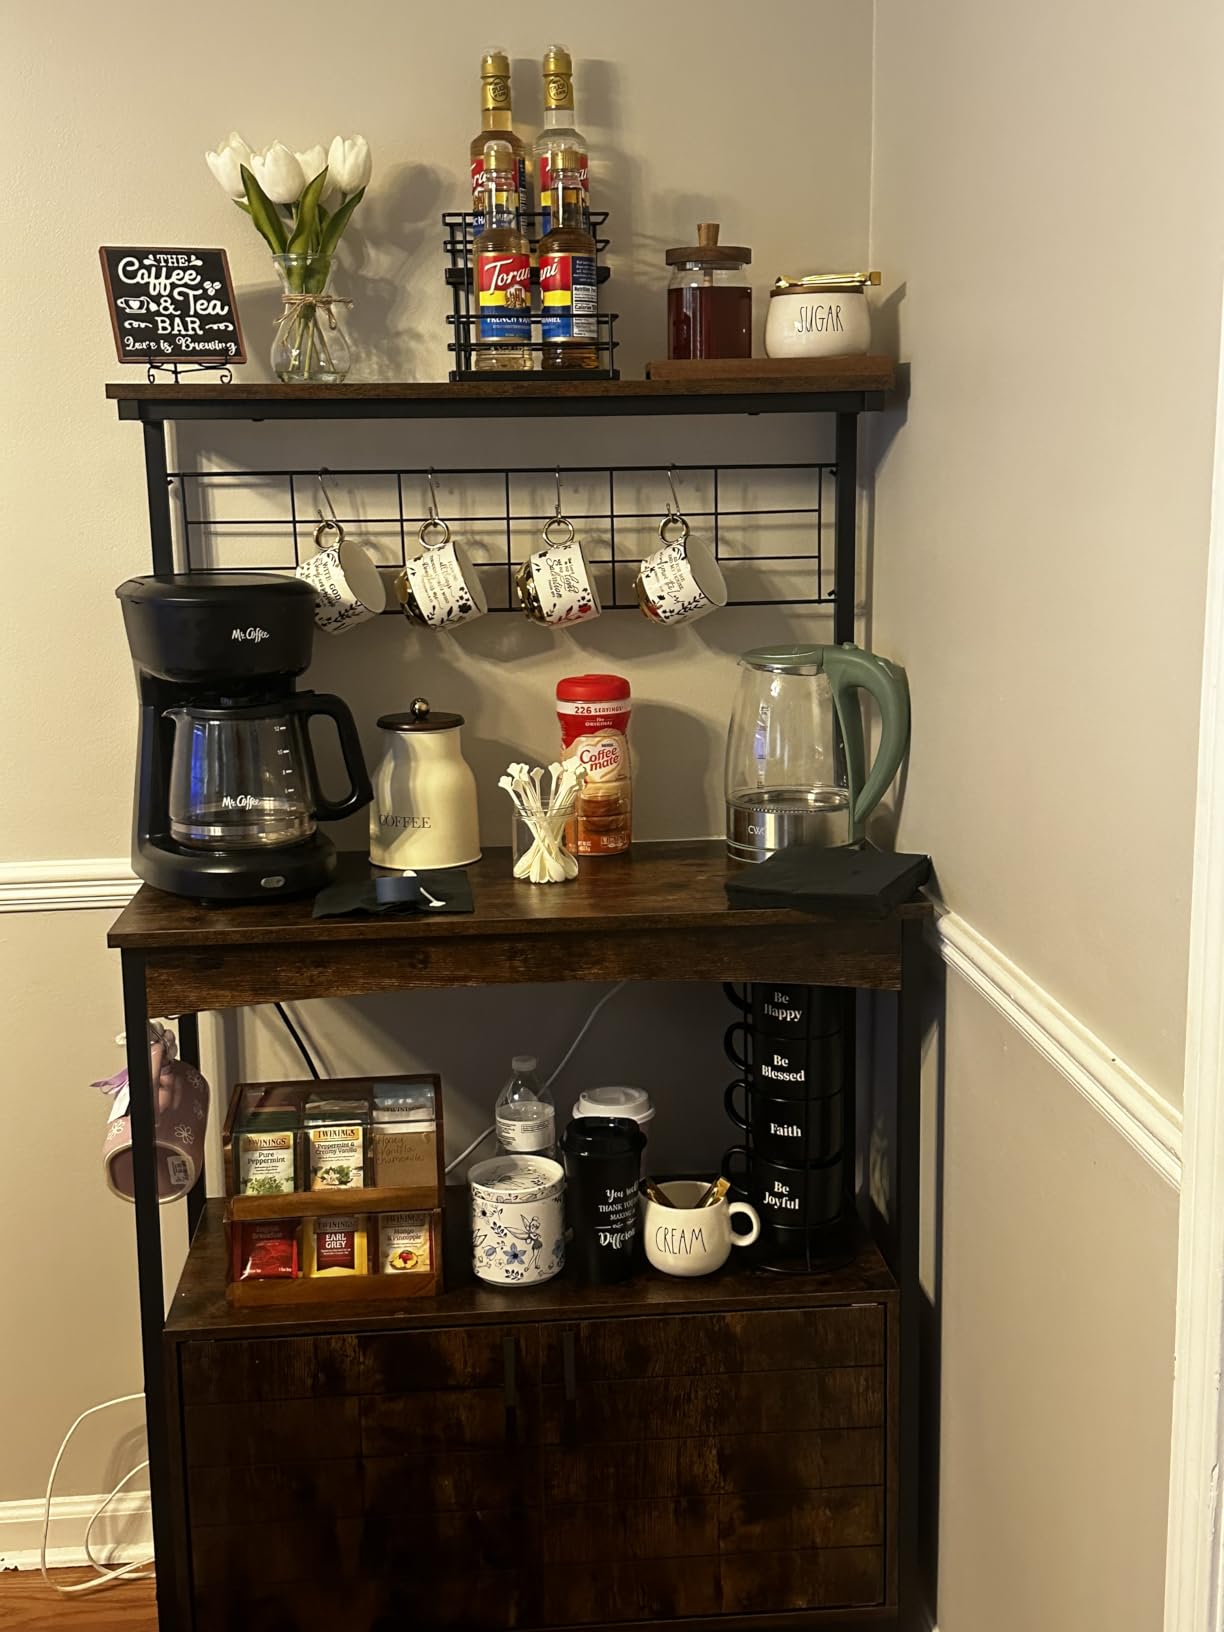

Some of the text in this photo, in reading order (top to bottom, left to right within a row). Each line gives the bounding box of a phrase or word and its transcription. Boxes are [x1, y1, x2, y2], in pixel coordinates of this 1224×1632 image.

[157, 255, 189, 267] THE
[118, 257, 201, 296] Coffee
[484, 258, 531, 295] Toran
[159, 287, 229, 315] & Tea
[154, 317, 204, 335] BAR
[797, 304, 844, 333] SUGAR
[124, 336, 237, 355] Love is Brewing
[329, 583, 342, 601] GOD
[246, 627, 270, 643] Coffee
[575, 706, 592, 714] 226
[580, 747, 618, 764] Coffee
[590, 755, 619, 771] mate
[236, 794, 261, 810] Coffee
[379, 815, 432, 829] COFFEE
[774, 991, 789, 1004] Be
[764, 1003, 803, 1022] Happy
[773, 1054, 789, 1067] Be
[761, 1065, 805, 1082] Blessed
[318, 1129, 356, 1138] TWININGS
[770, 1122, 802, 1137] Faith
[247, 1136, 288, 1147] TWININGS
[247, 1156, 286, 1165] Peppermint
[258, 1151, 275, 1159] Pure
[774, 1181, 790, 1194] Be
[605, 1189, 624, 1203] You
[763, 1192, 800, 1210] Joyful
[597, 1203, 623, 1212] THANK
[325, 1232, 347, 1241] EARL
[655, 1226, 707, 1255] CREAM
[325, 1240, 347, 1249] GREY
